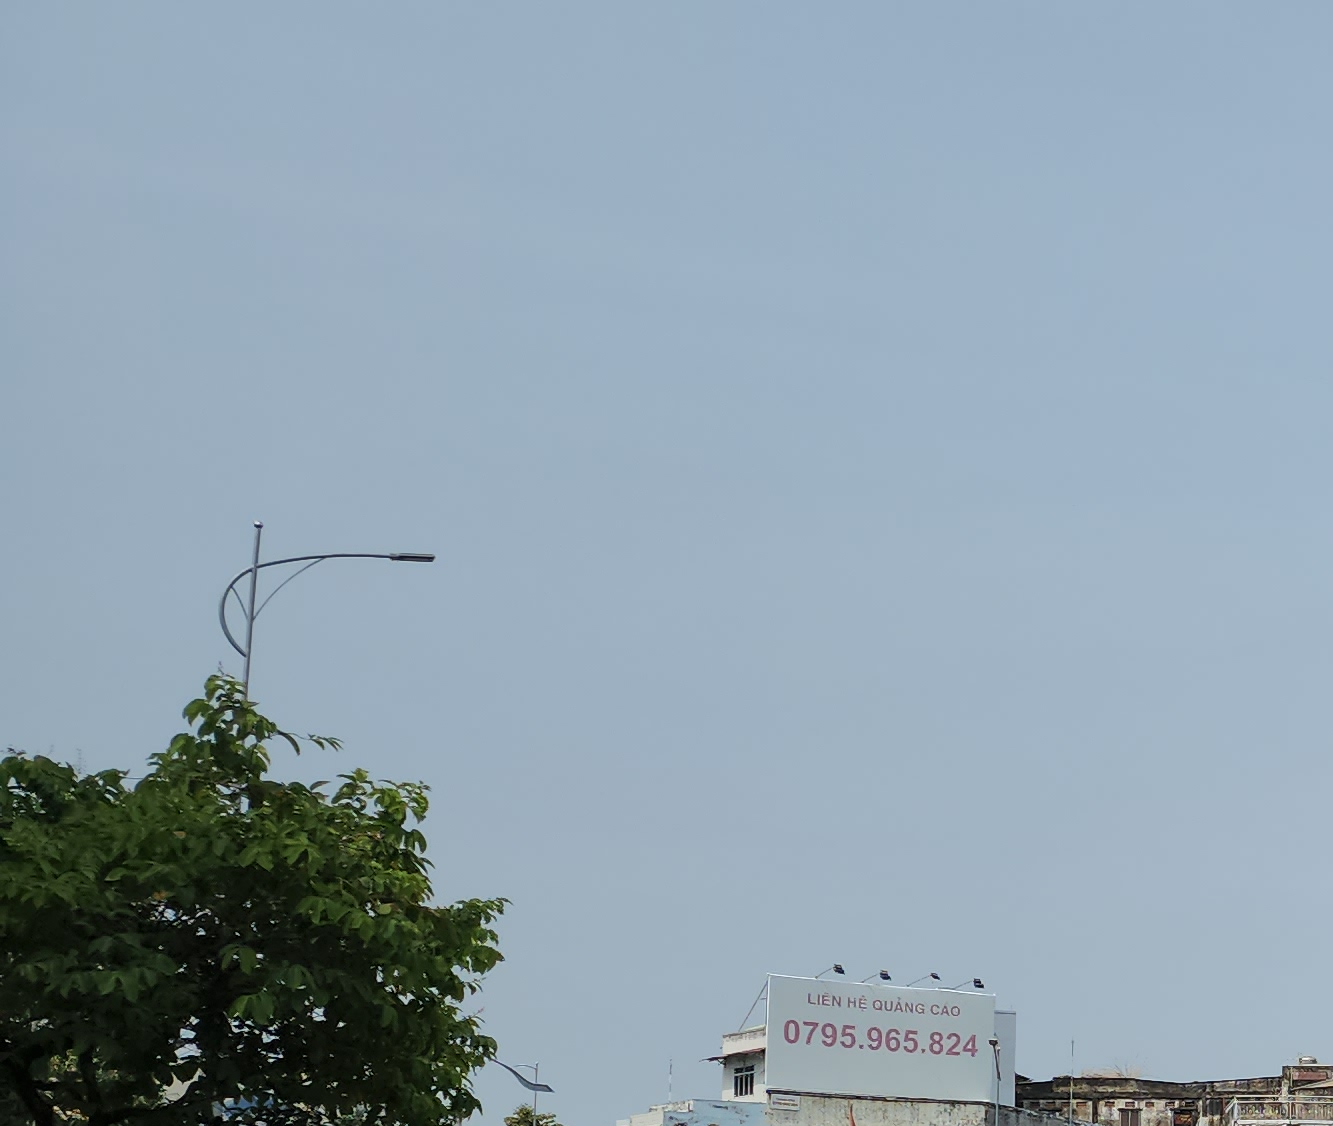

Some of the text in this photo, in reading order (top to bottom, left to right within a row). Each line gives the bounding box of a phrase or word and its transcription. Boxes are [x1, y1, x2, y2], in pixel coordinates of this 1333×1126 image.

[807, 992, 841, 1007] LIÊN
[848, 996, 867, 1011] HỆ
[873, 997, 925, 1014] QUẢNG
[783, 1019, 978, 1057] 0795.965.824
